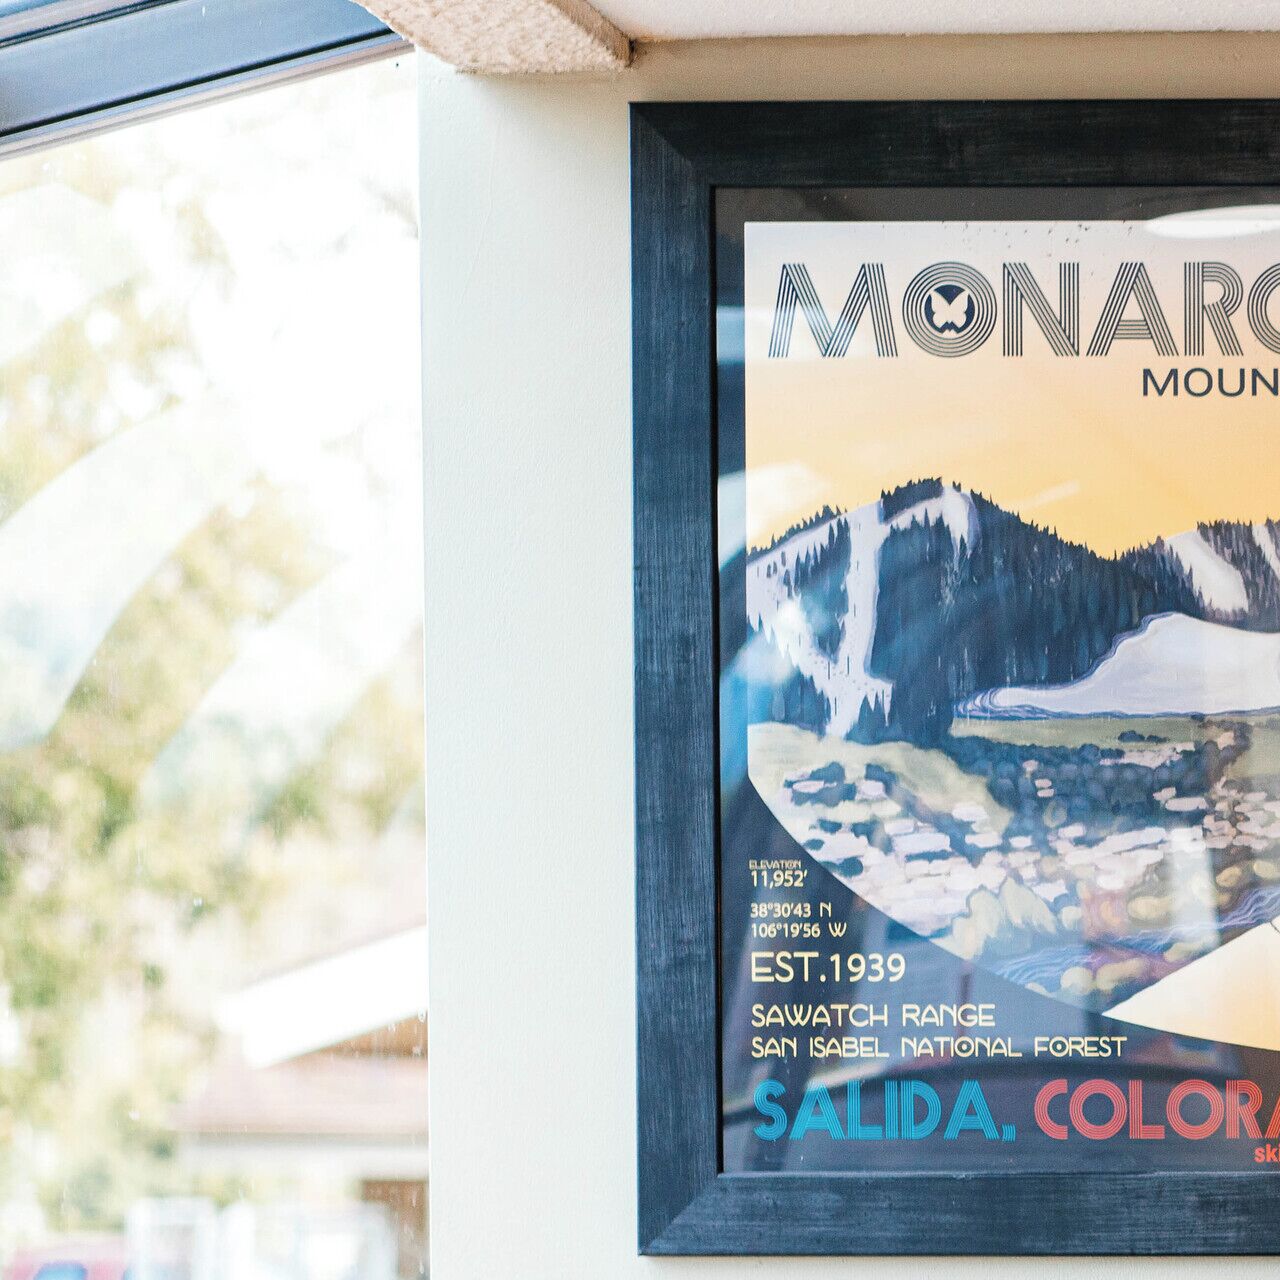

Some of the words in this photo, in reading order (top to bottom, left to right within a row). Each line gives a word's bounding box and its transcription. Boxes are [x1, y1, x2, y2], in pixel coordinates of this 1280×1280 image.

[749, 859, 802, 870] ELEVATION
[819, 902, 833, 918] N
[828, 922, 848, 938] W
[751, 951, 906, 982] EST.1939
[751, 1003, 889, 1028] SAWATCH
[901, 1003, 997, 1027] RANGE
[751, 1036, 798, 1058] SAN
[809, 1036, 890, 1058] ISABEL
[901, 1036, 1023, 1058] NATIONAL
[1034, 1036, 1128, 1058] FOREST
